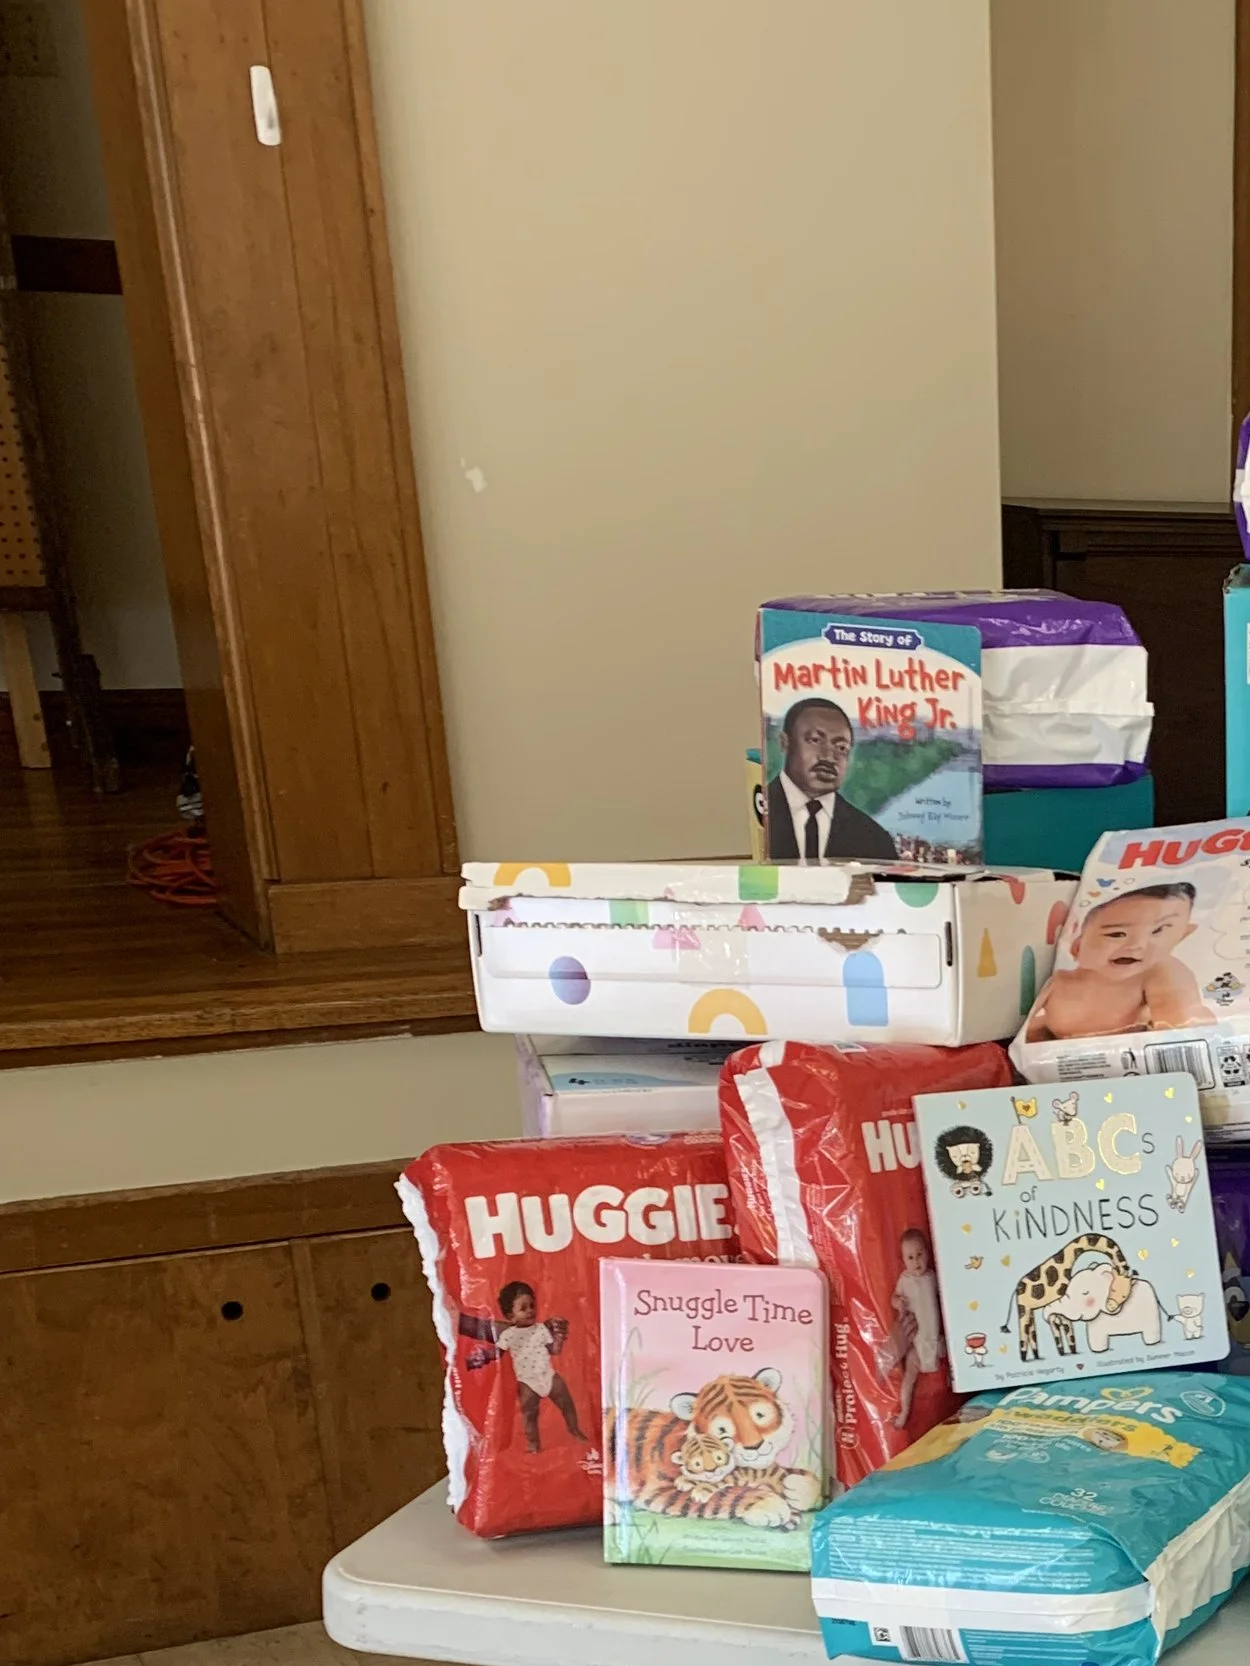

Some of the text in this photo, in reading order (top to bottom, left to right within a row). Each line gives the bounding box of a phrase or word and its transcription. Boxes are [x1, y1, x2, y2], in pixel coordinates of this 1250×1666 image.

[833, 629, 913, 647] The Story of
[773, 656, 966, 692] Martin Luther
[857, 697, 957, 741] King Jr.
[1020, 1186, 1038, 1203] of
[464, 1184, 738, 1260] HUGGIE
[634, 1289, 814, 1325] Snuggle Time
[692, 1325, 755, 1352] Love
[998, 1386, 1184, 1424] Pampers
[1070, 1487, 1098, 1501] 32
